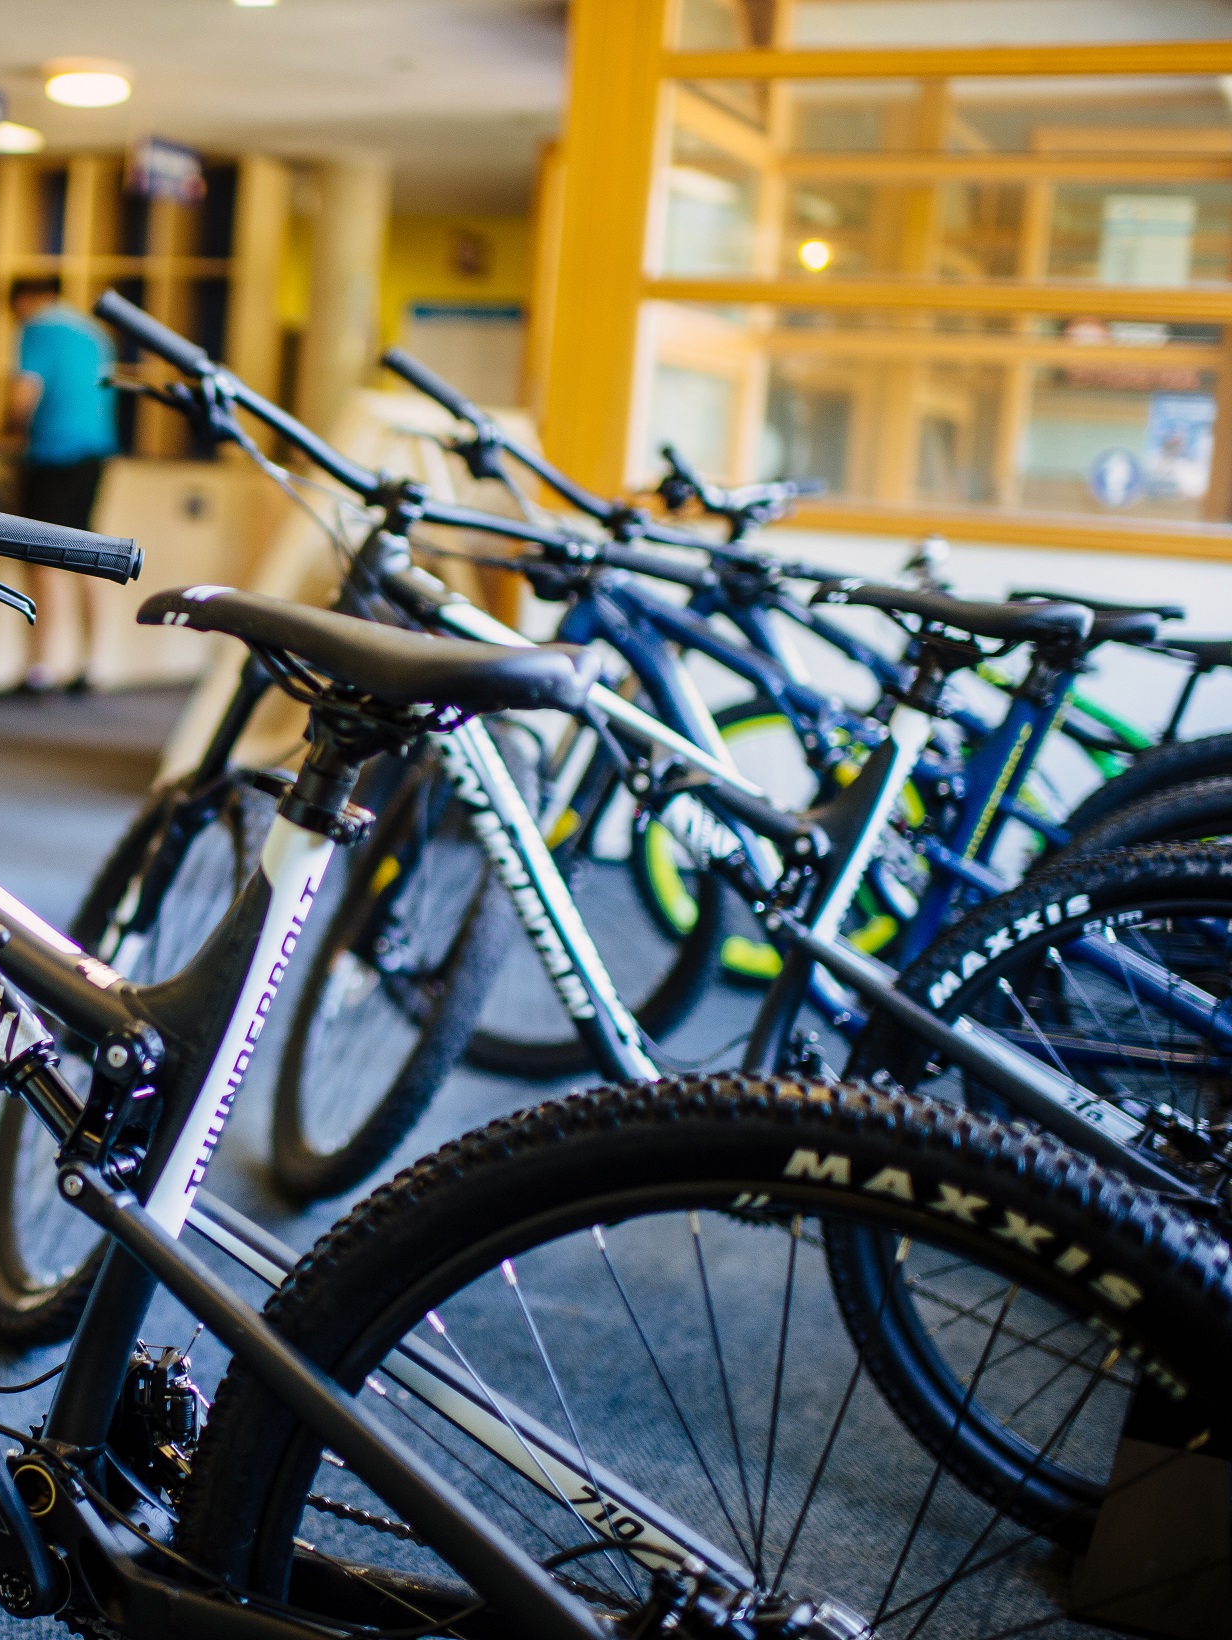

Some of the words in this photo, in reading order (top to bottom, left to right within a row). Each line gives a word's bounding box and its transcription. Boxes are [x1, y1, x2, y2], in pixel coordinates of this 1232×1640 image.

[929, 893, 1091, 1009] MAXXIS
[183, 876, 322, 1196] THUNDERBOLT
[782, 1147, 1145, 1308] MAXXIS
[570, 1484, 646, 1540] 710
